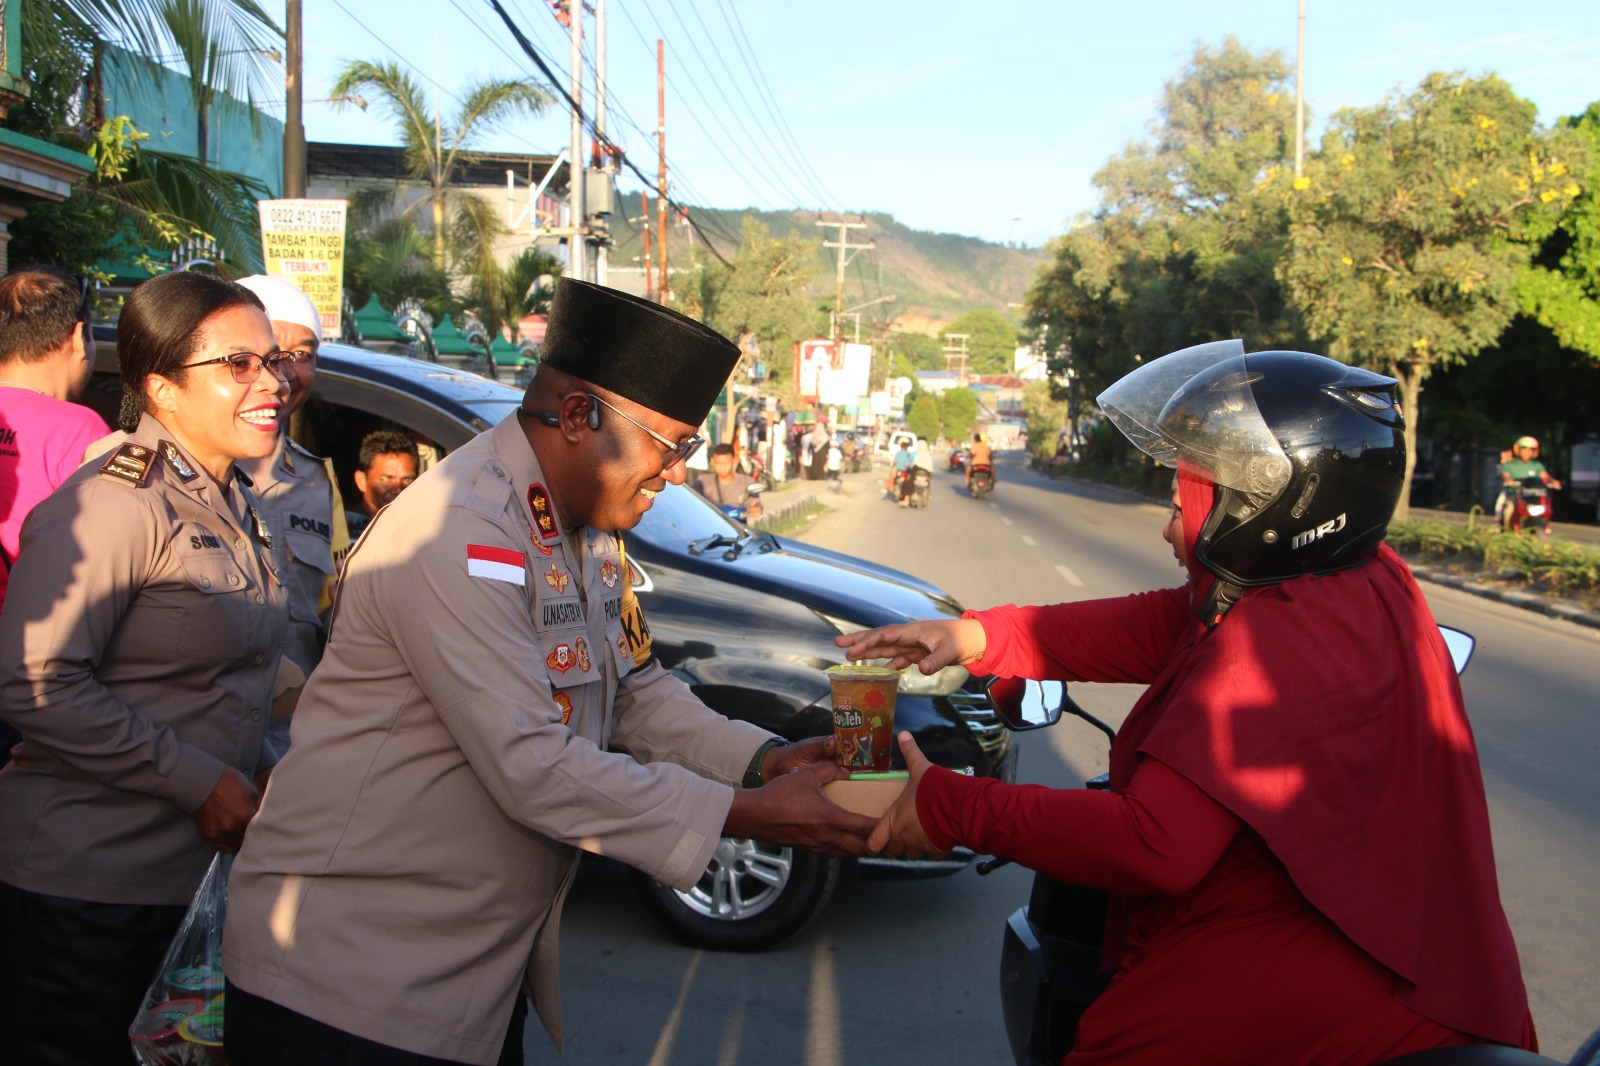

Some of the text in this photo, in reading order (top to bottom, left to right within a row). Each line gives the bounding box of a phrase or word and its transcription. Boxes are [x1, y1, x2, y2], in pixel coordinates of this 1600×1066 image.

[266, 233, 342, 248] TAMBAH TINGGI
[268, 247, 305, 259] BADAN
[327, 249, 341, 260] CM
[284, 261, 329, 272] TERBUKTI
[290, 513, 330, 539] POLRI
[1292, 512, 1347, 550] MRJ
[844, 711, 862, 726] Teh
